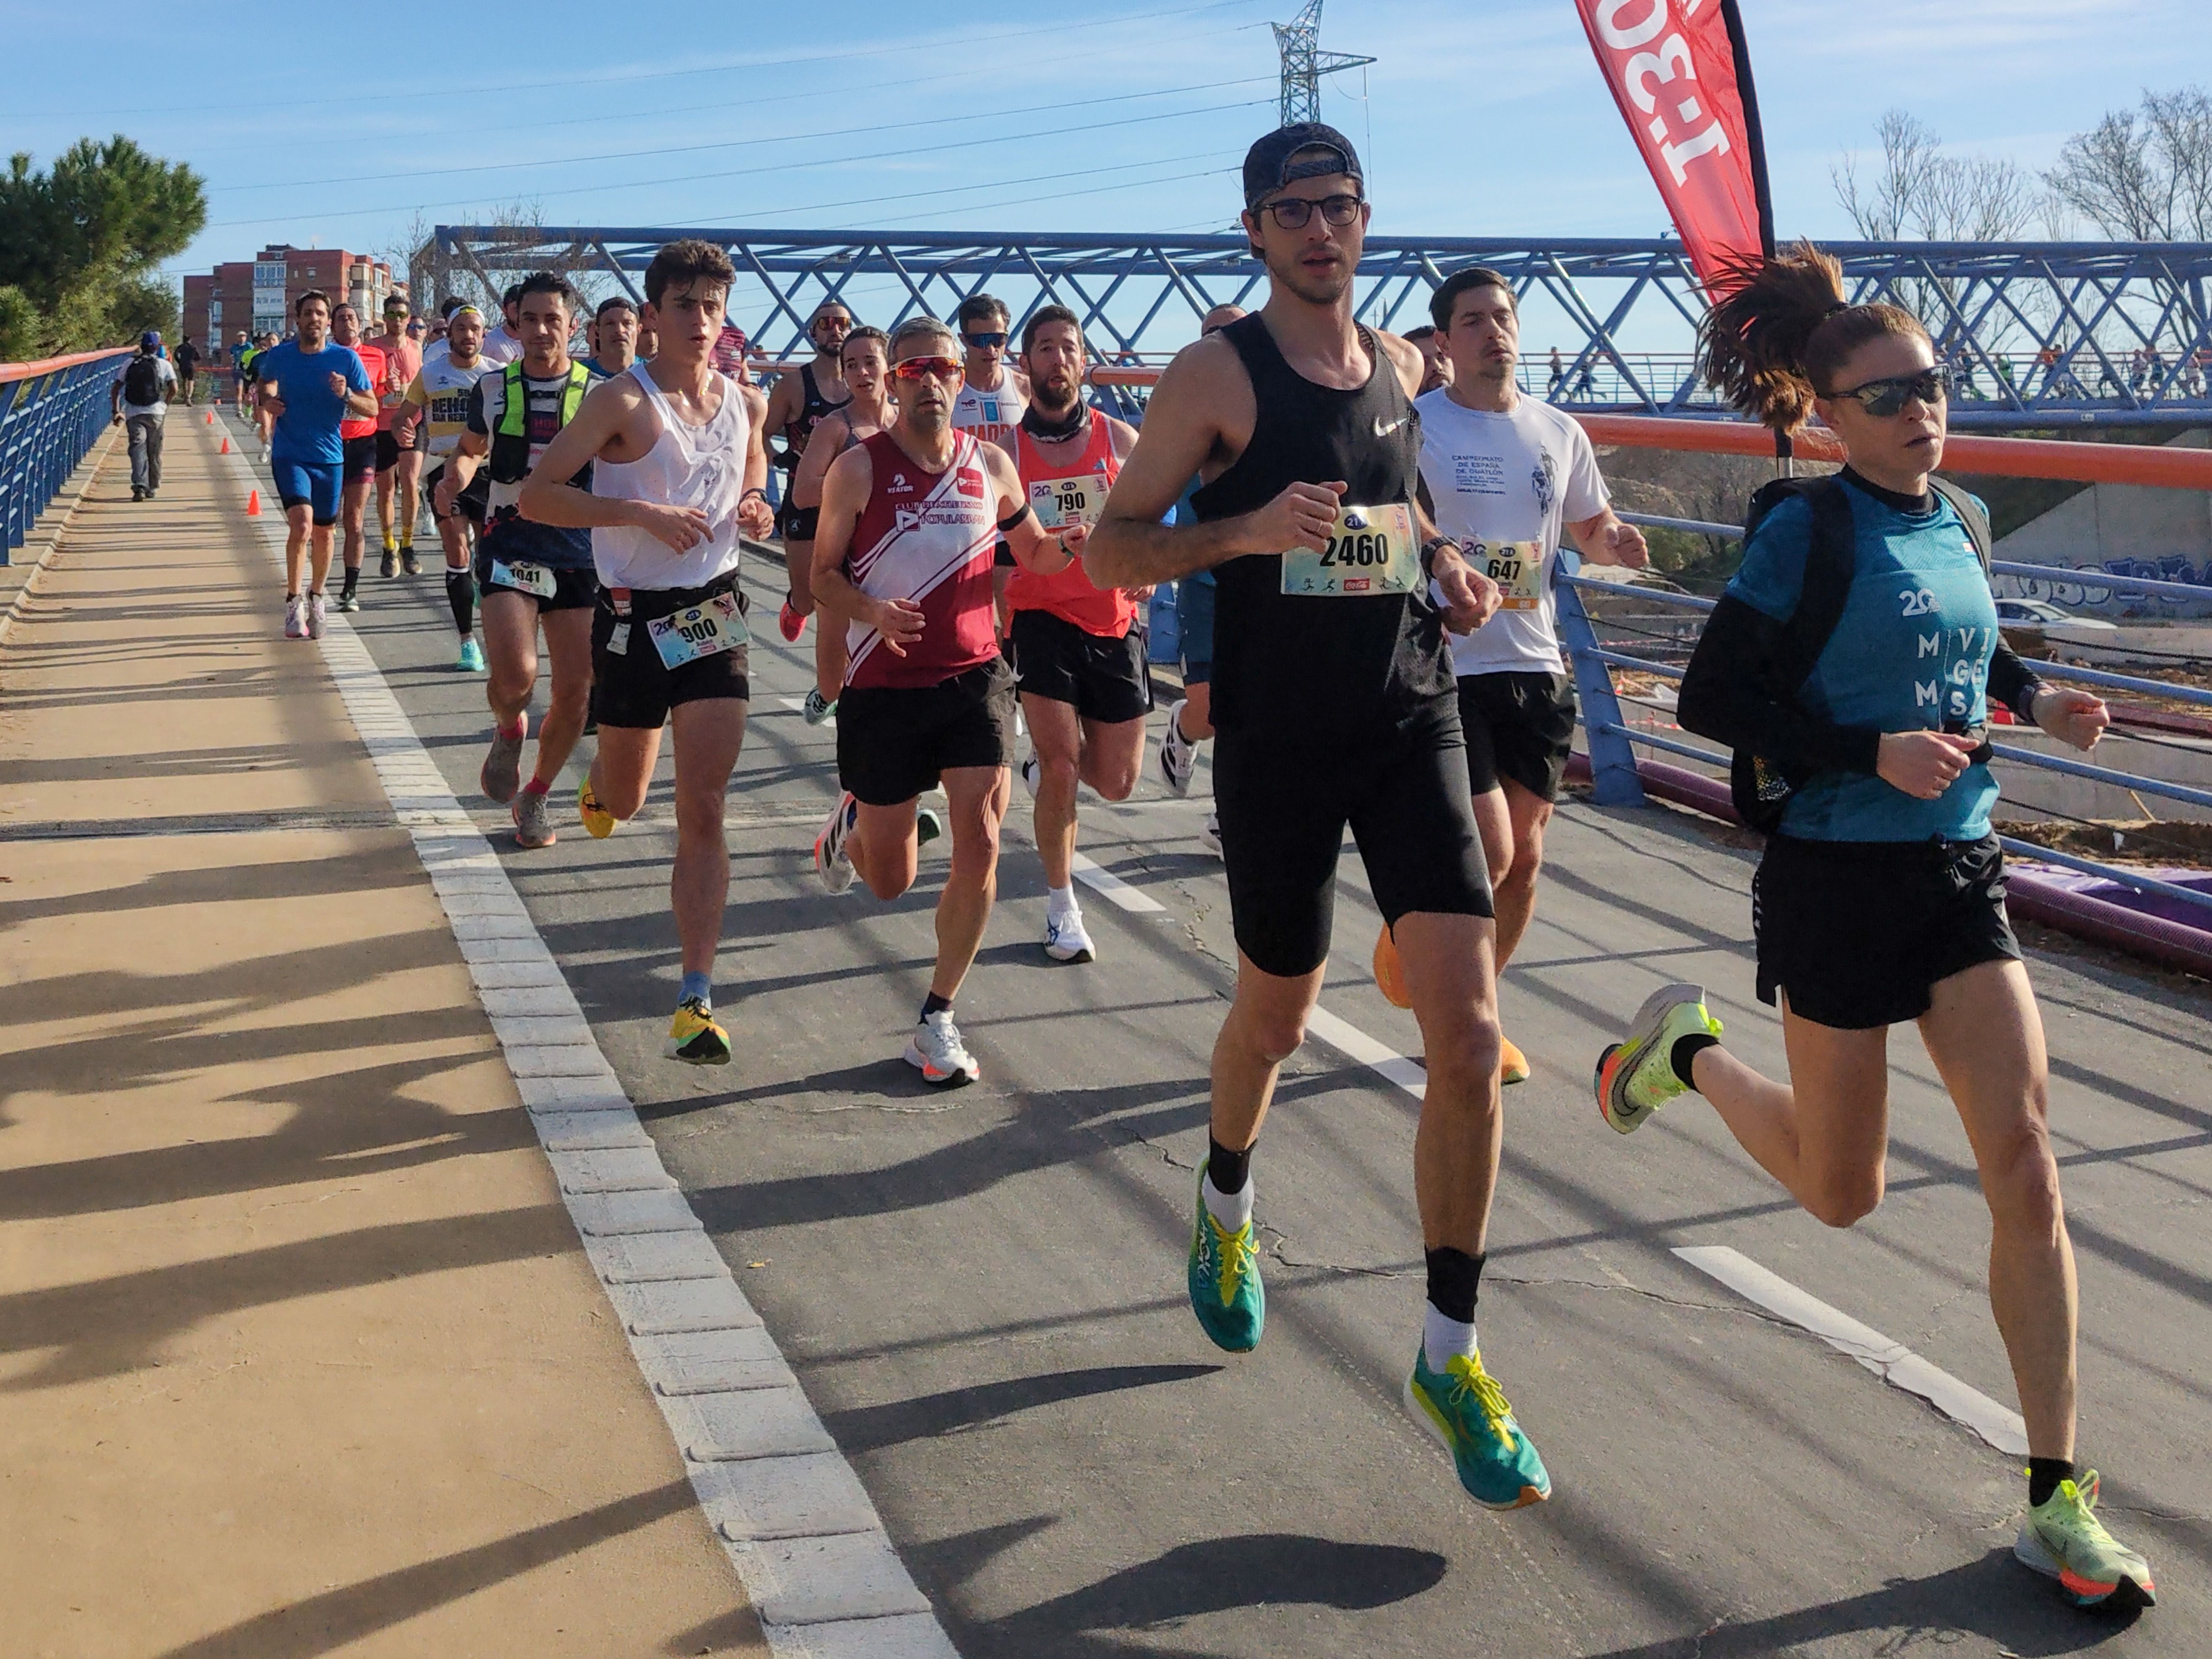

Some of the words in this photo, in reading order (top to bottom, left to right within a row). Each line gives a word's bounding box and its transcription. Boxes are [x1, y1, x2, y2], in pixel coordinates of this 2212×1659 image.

[1055, 492, 1085, 511] 790
[1320, 533, 1389, 567] 2460
[510, 568, 540, 583] 1041
[1487, 559, 1521, 581] 647
[680, 618, 718, 643] 900
